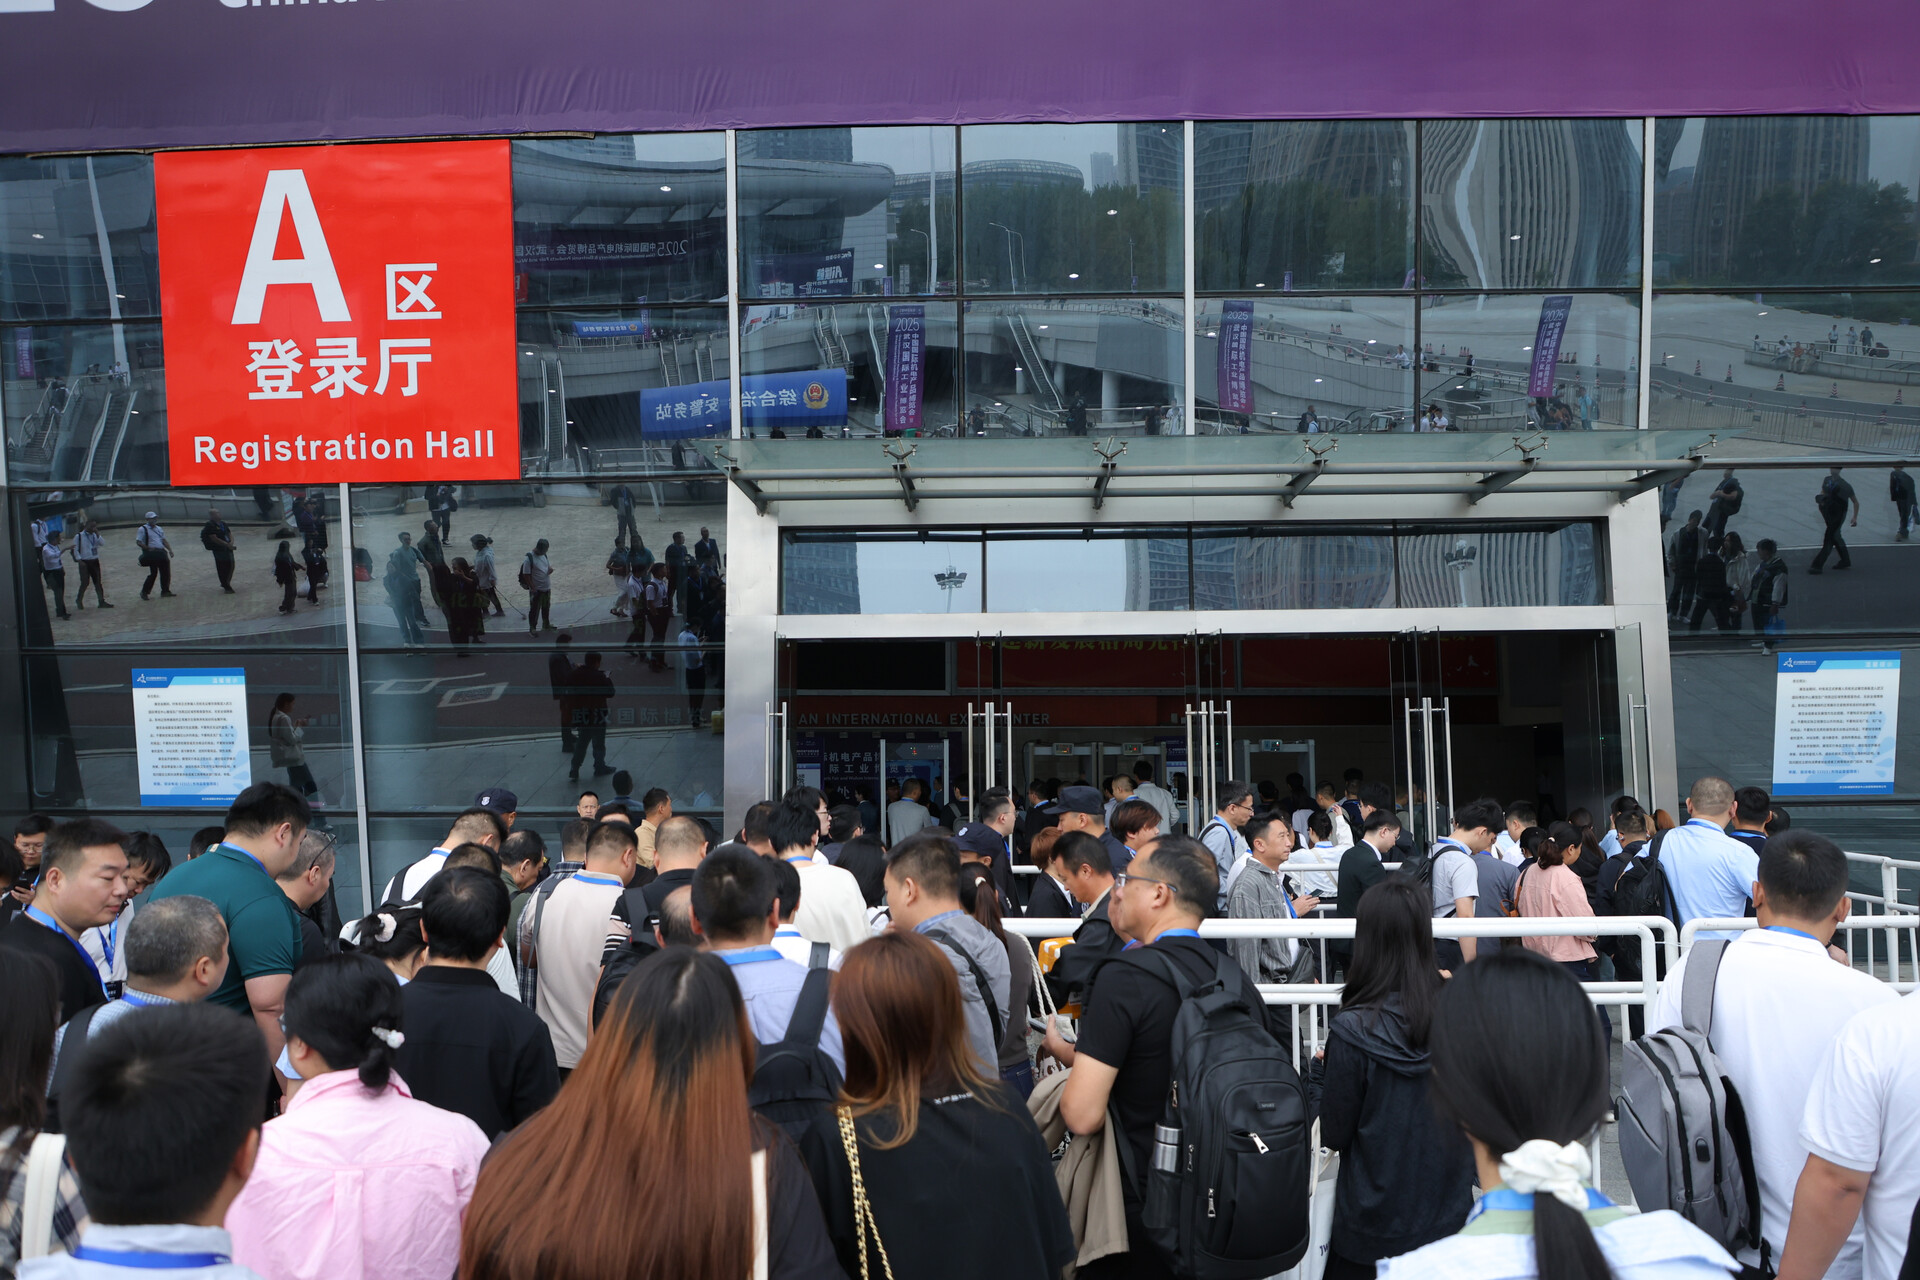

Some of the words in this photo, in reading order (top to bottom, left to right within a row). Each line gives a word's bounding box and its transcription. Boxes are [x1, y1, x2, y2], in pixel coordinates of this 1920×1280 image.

[231, 168, 351, 325] A
[386, 263, 442, 321] 区
[895, 318, 920, 332] 2025
[1227, 311, 1248, 321] 2025
[246, 337, 432, 401] 登录厅
[194, 430, 414, 469] Registration
[425, 428, 495, 459] Hall
[826, 713, 942, 725] INTERNATIONAL
